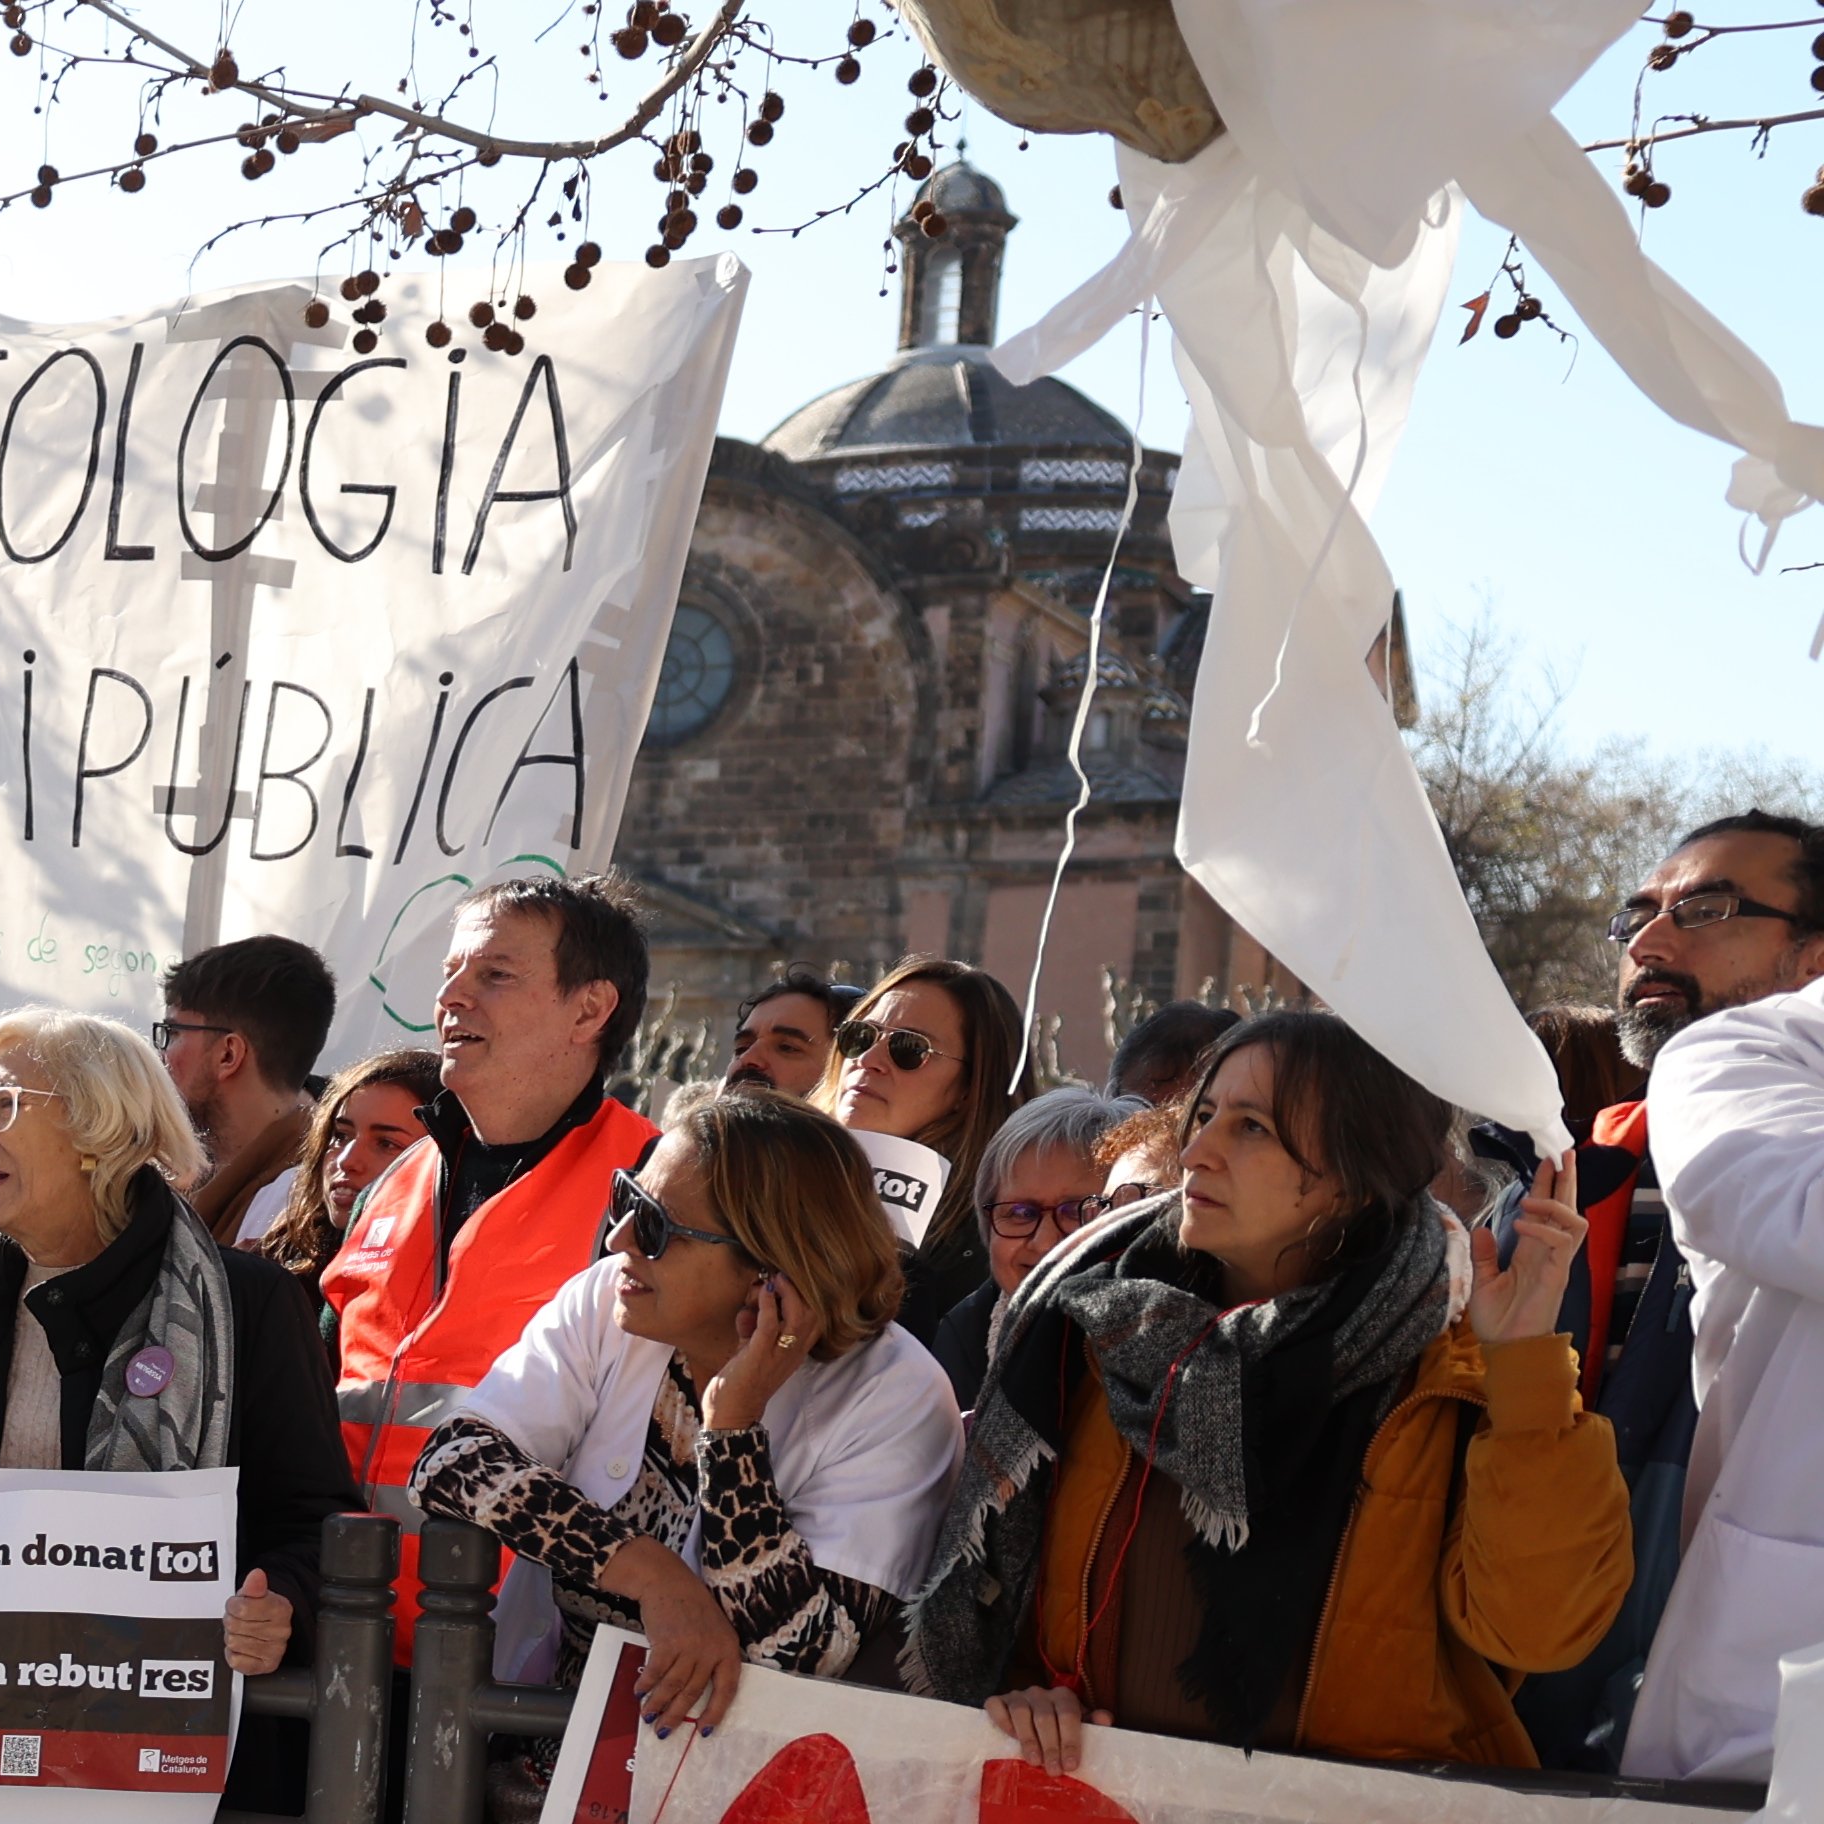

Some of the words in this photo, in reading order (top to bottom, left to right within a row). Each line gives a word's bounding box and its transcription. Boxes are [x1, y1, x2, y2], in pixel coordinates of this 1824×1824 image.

[873, 1170, 922, 1204] tot
[21, 1533, 146, 1572] donat
[156, 1544, 215, 1575] tot
[16, 1653, 134, 1691] rebut
[143, 1668, 210, 1693] res
[160, 1764, 207, 1776] Catalunya
[161, 1754, 195, 1766] Metges
[195, 1755, 208, 1764] de
